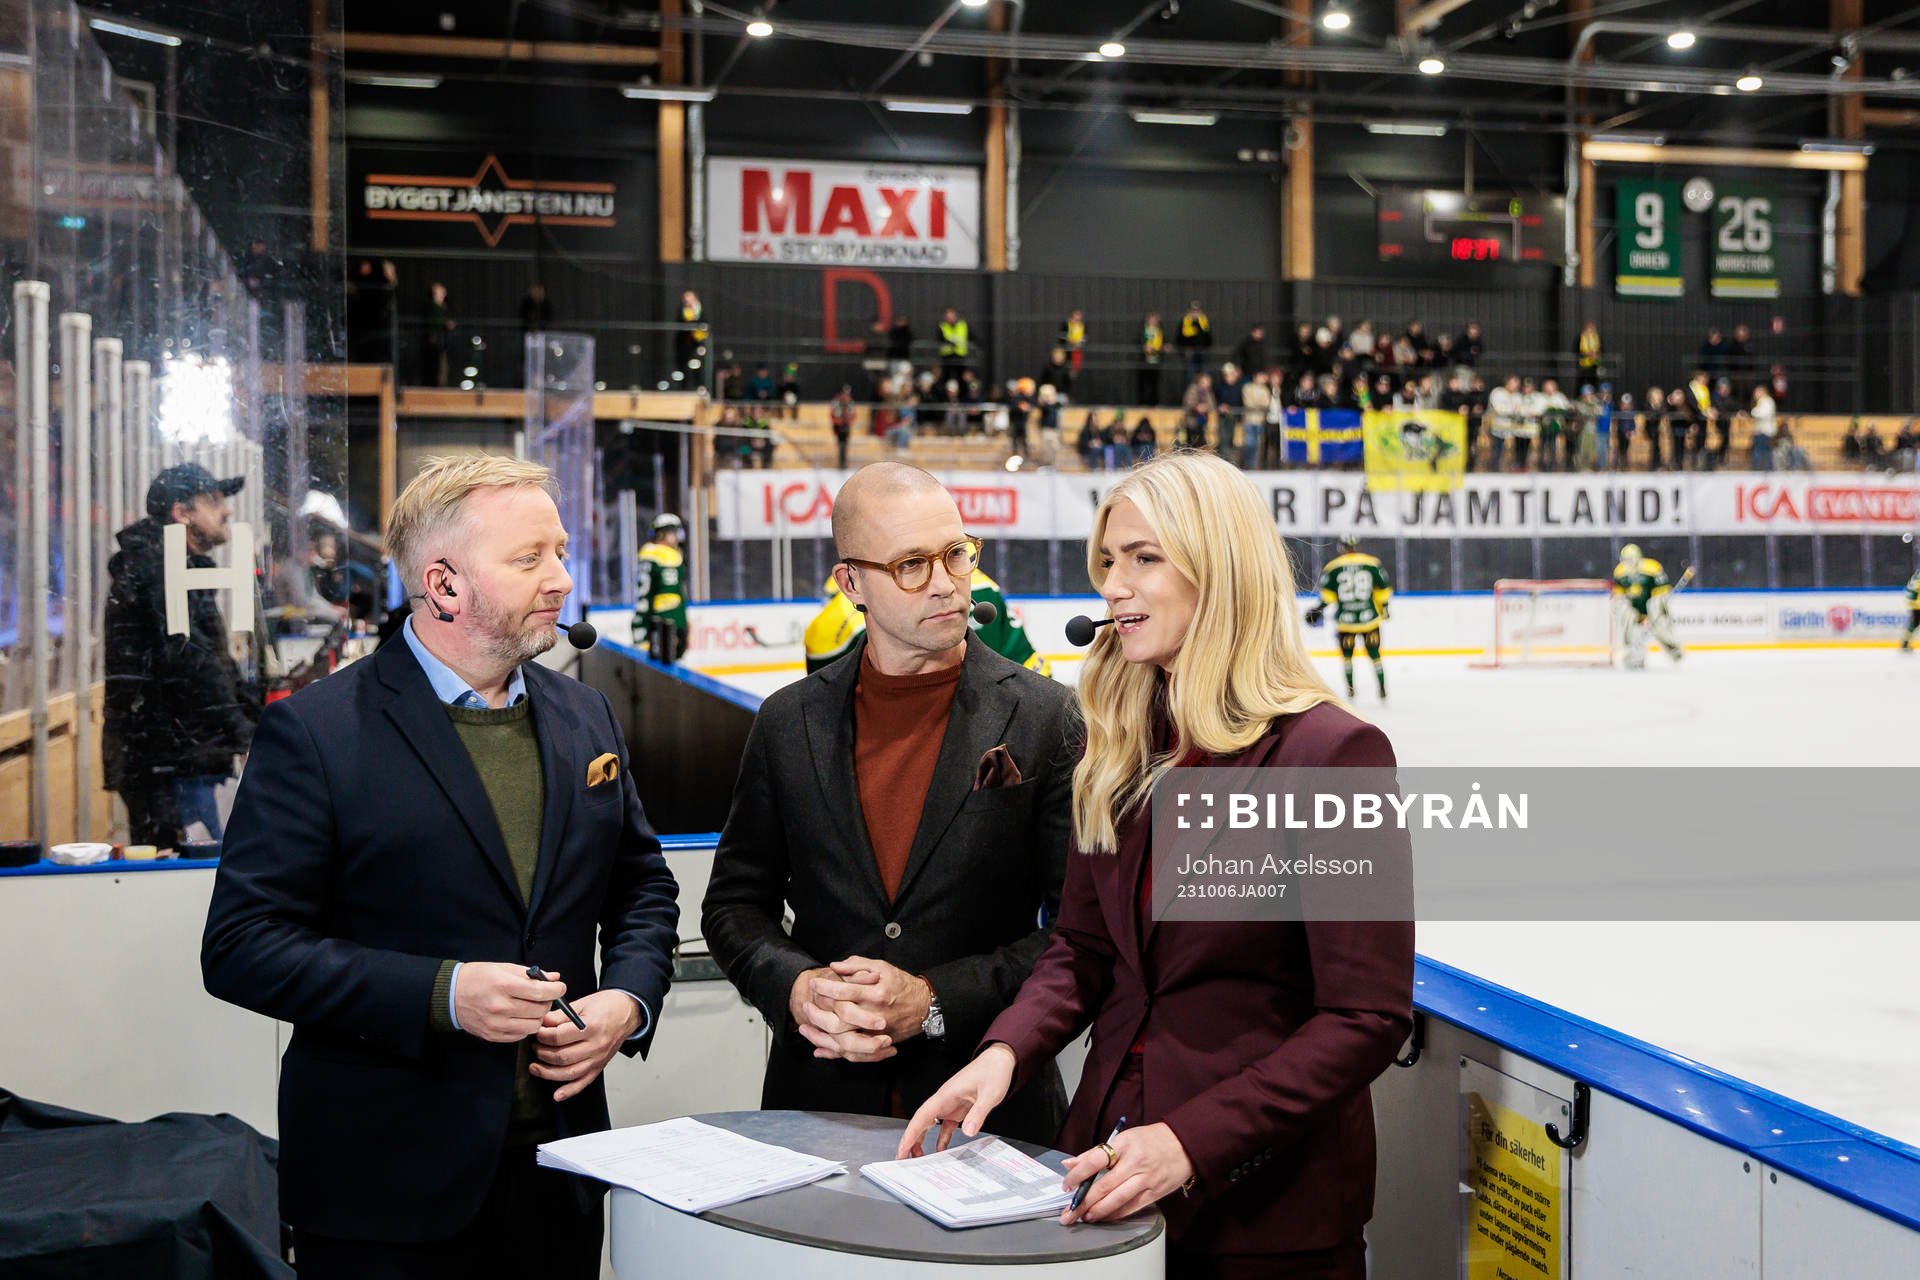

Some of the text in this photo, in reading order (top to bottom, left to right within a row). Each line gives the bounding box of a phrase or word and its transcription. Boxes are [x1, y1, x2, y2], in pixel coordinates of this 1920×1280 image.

[741, 168, 947, 239] MAXI
[1635, 192, 1664, 249] 9
[1718, 196, 1772, 252] 26
[823, 267, 893, 353] D
[763, 483, 834, 525] ICA
[1736, 483, 1801, 523] ICA
[164, 522, 257, 638] H
[1495, 1130, 1508, 1151] din
[1510, 1139, 1545, 1171] säkerhet
